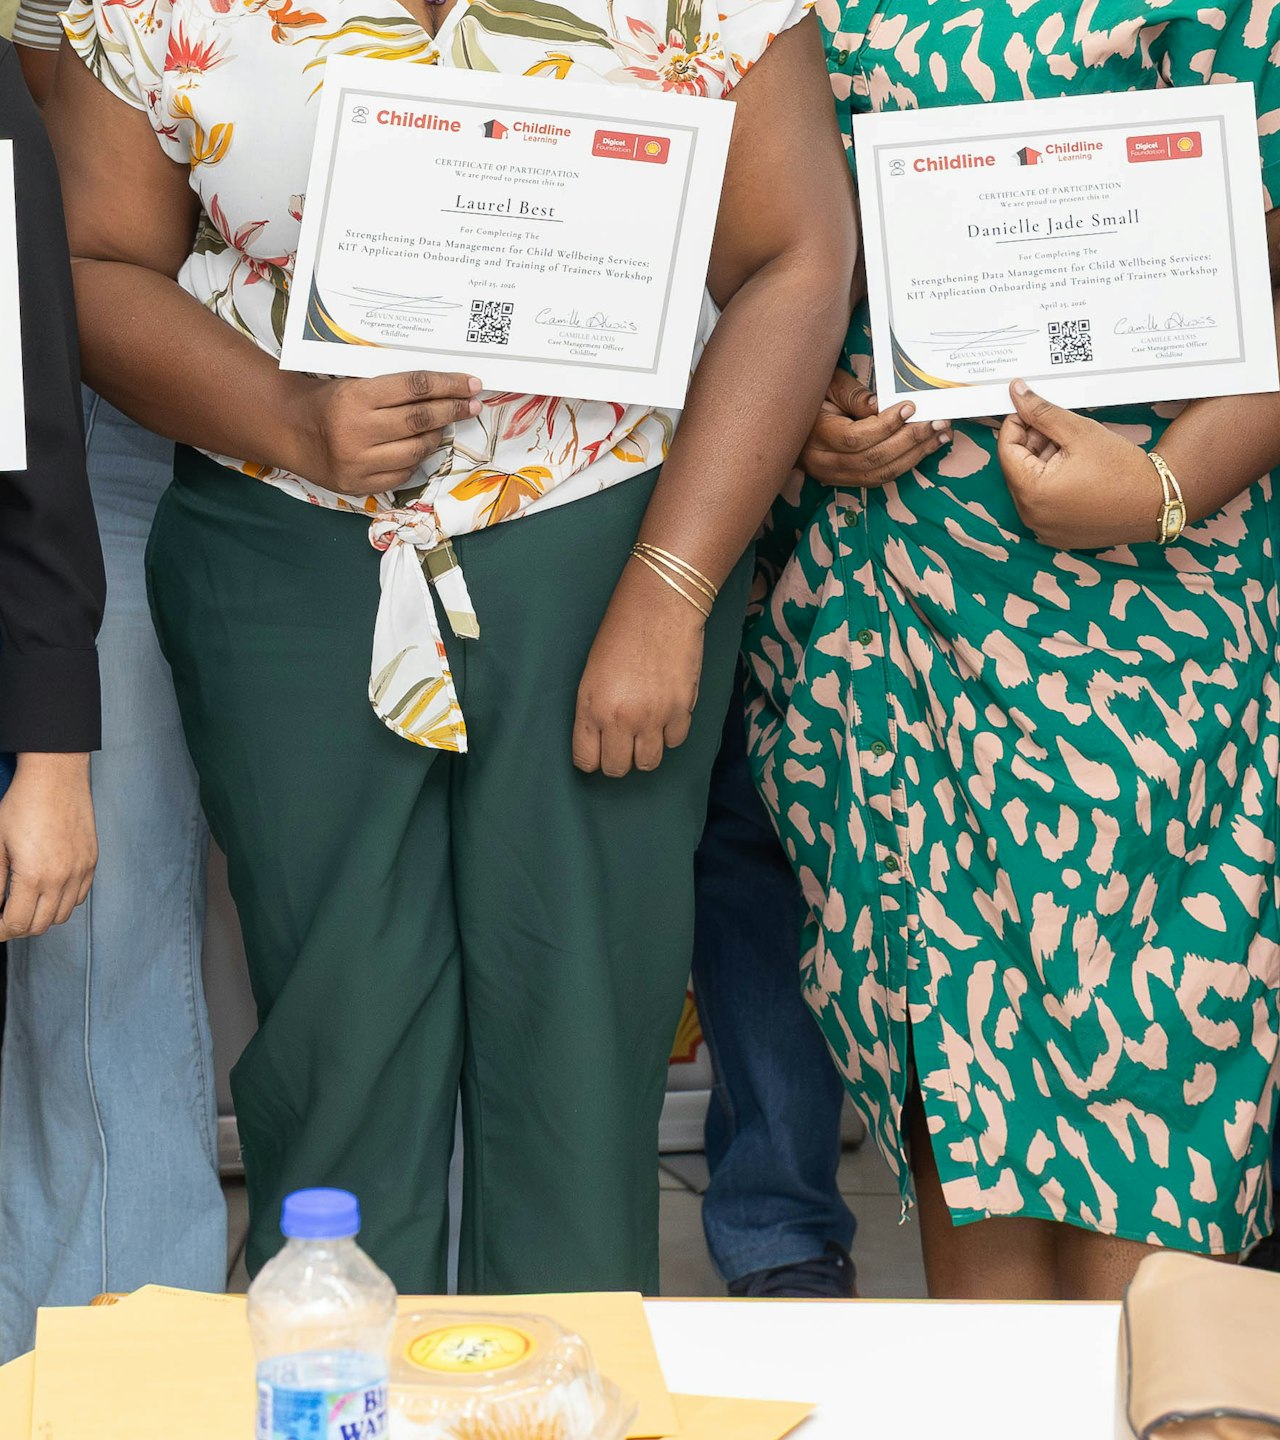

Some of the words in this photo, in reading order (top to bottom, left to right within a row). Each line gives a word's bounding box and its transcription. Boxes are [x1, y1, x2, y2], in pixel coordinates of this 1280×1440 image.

[376, 109, 461, 133] Childline
[513, 121, 571, 137] Childline
[523, 134, 558, 146] Learning
[599, 137, 626, 147] Digicel
[1045, 141, 1103, 155] Childline
[1135, 141, 1159, 152] Digicel
[913, 153, 996, 173] Childline
[1057, 153, 1093, 162] Learning
[435, 158, 493, 171] CERTIFICATE
[495, 164, 507, 172] OF
[509, 165, 580, 179] PARTICIPATION
[978, 189, 1036, 201] CERTIFICATE
[1052, 182, 1121, 194] PARTICIPATION
[456, 194, 511, 213] Laurel
[519, 201, 555, 217] Best
[967, 218, 1039, 238] Danielle
[1046, 214, 1083, 236] Jade
[1091, 208, 1139, 227] Small
[345, 229, 415, 246] Strengthening
[418, 236, 441, 247] Data
[445, 239, 506, 253] Management
[509, 244, 524, 254] for
[526, 247, 554, 257] Child
[557, 250, 604, 266] Wellbeing
[607, 255, 650, 268] Services:
[338, 242, 358, 252] KIT
[360, 245, 419, 259] Application
[423, 251, 481, 268] Onboarding
[484, 257, 502, 267] and
[505, 259, 546, 273] Training
[548, 262, 561, 272] of
[562, 264, 601, 276] Trainers
[605, 268, 653, 284] Workshop
